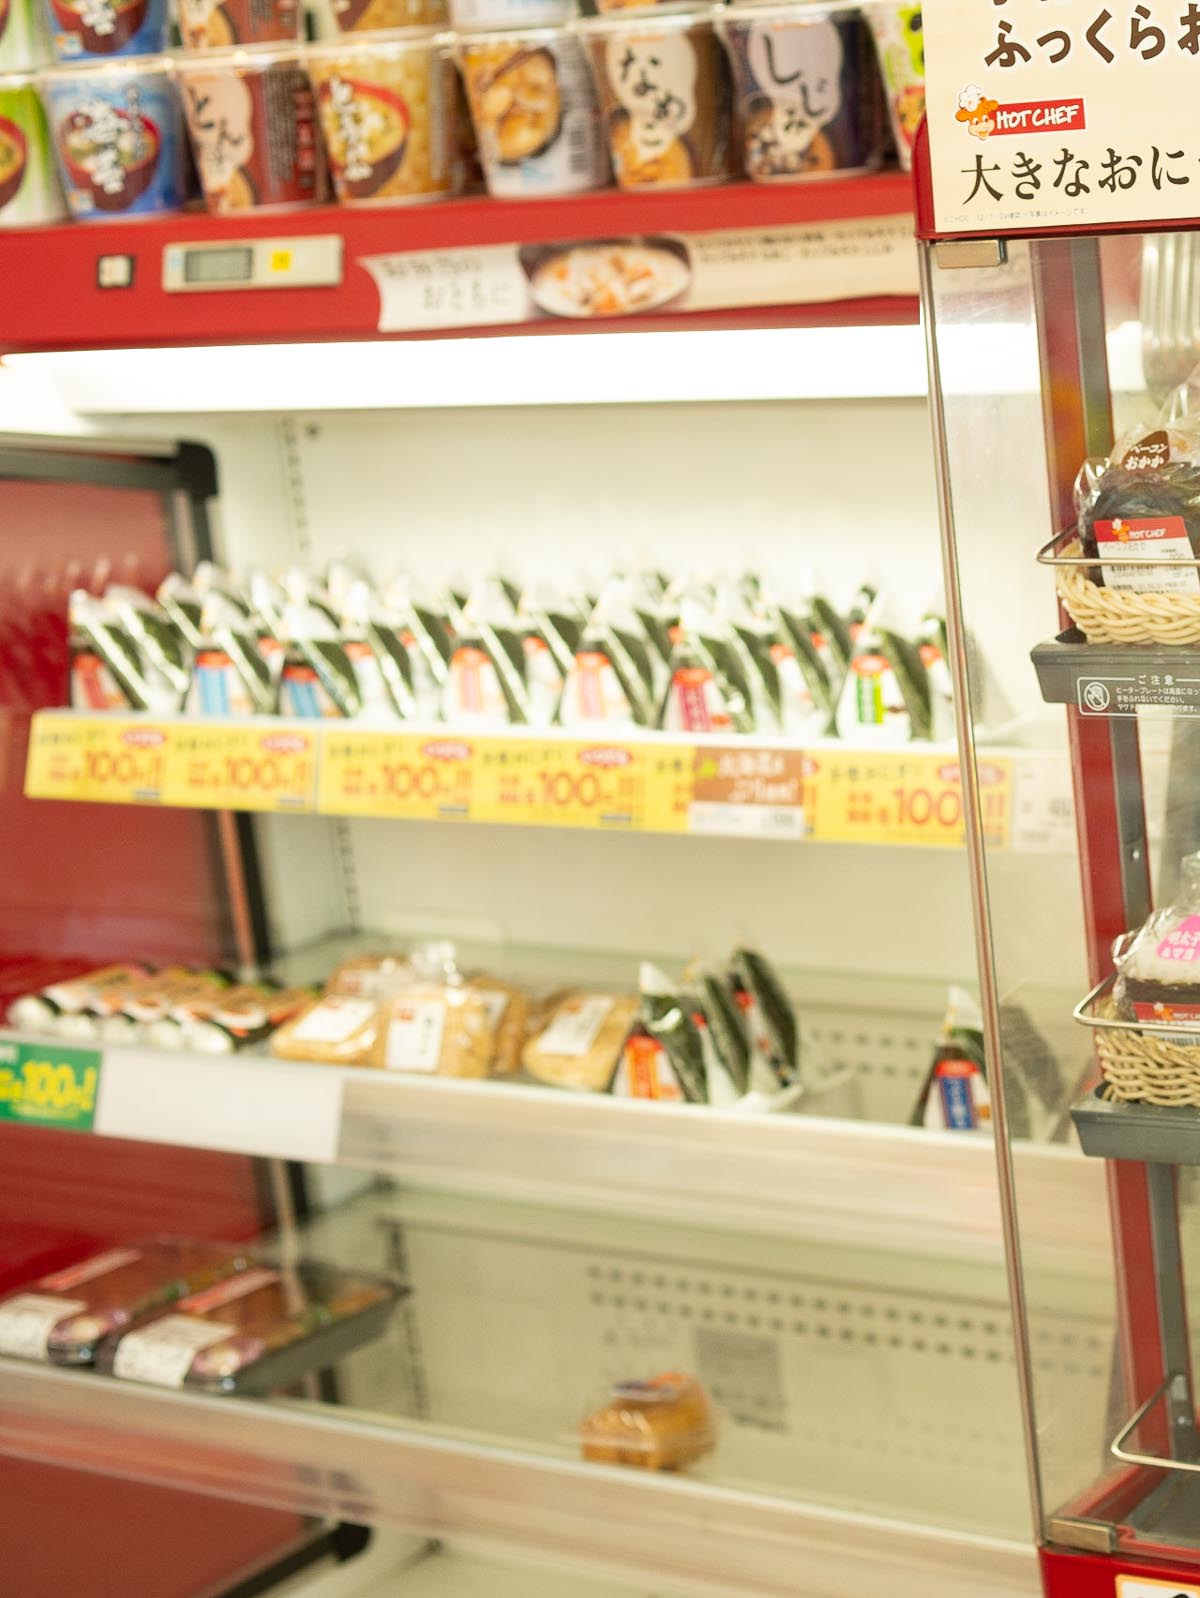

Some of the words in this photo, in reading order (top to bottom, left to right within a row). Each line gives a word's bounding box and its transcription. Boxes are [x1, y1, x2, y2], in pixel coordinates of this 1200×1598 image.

[996, 110, 1029, 129] HOT
[1032, 104, 1081, 126] CHEF
[1131, 442, 1168, 454] ベーコン
[1124, 454, 1164, 471] おかか
[1138, 675, 1175, 685] ご注意
